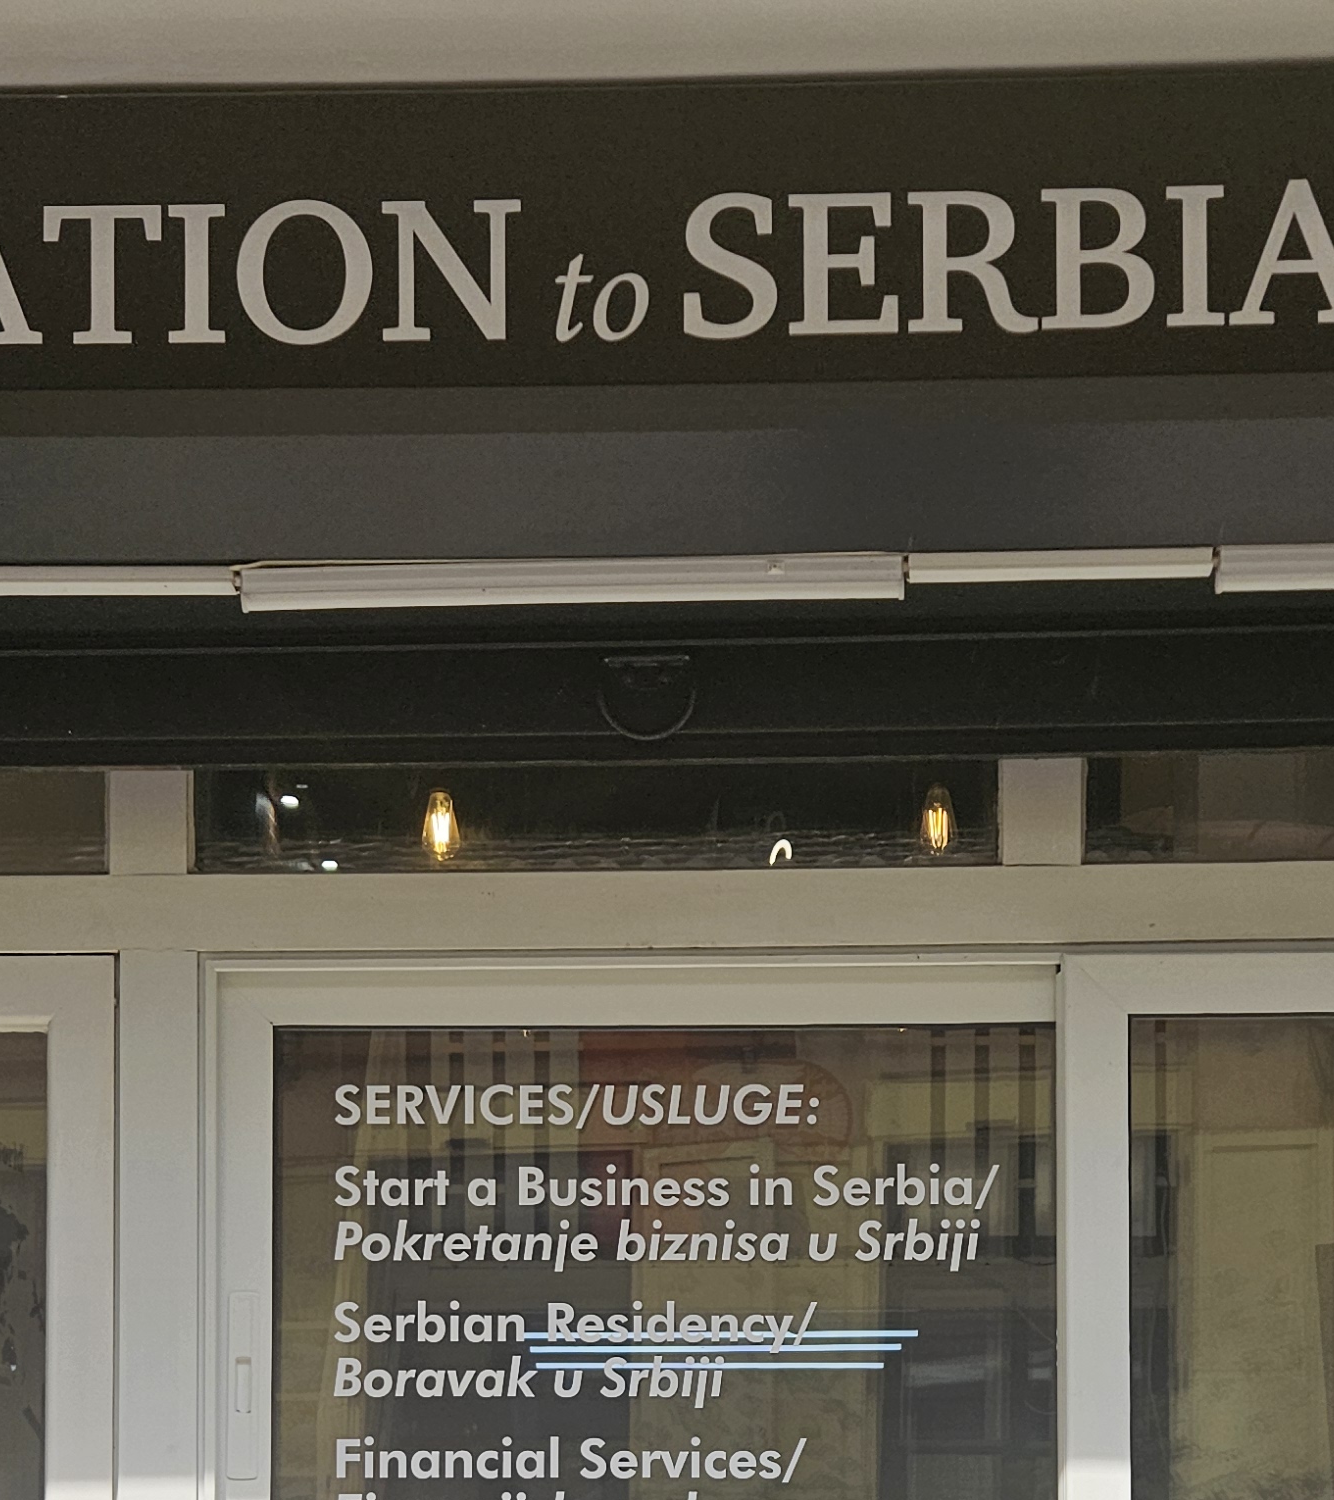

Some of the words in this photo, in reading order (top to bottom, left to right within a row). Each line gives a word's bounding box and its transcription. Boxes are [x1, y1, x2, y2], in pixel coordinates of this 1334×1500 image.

[554, 253, 650, 343] to
[334, 1083, 820, 1130] SERVICES/USLUGE:
[334, 1165, 450, 1207] Start
[467, 1178, 496, 1207] a
[518, 1163, 730, 1207] Business
[749, 1163, 793, 1206] in
[812, 1163, 1000, 1210] Serbia/
[334, 1219, 598, 1273] Pokretanje
[616, 1218, 790, 1262] biznisa
[808, 1233, 838, 1262] u
[854, 1218, 981, 1272] Srbiji
[332, 1300, 527, 1346] Serbian
[545, 1301, 819, 1353] Residency/
[332, 1357, 538, 1400] Boravak
[553, 1368, 583, 1399] u
[599, 1357, 725, 1408] Srbiji
[335, 1435, 560, 1480] Financial
[579, 1436, 808, 1483] Services/
